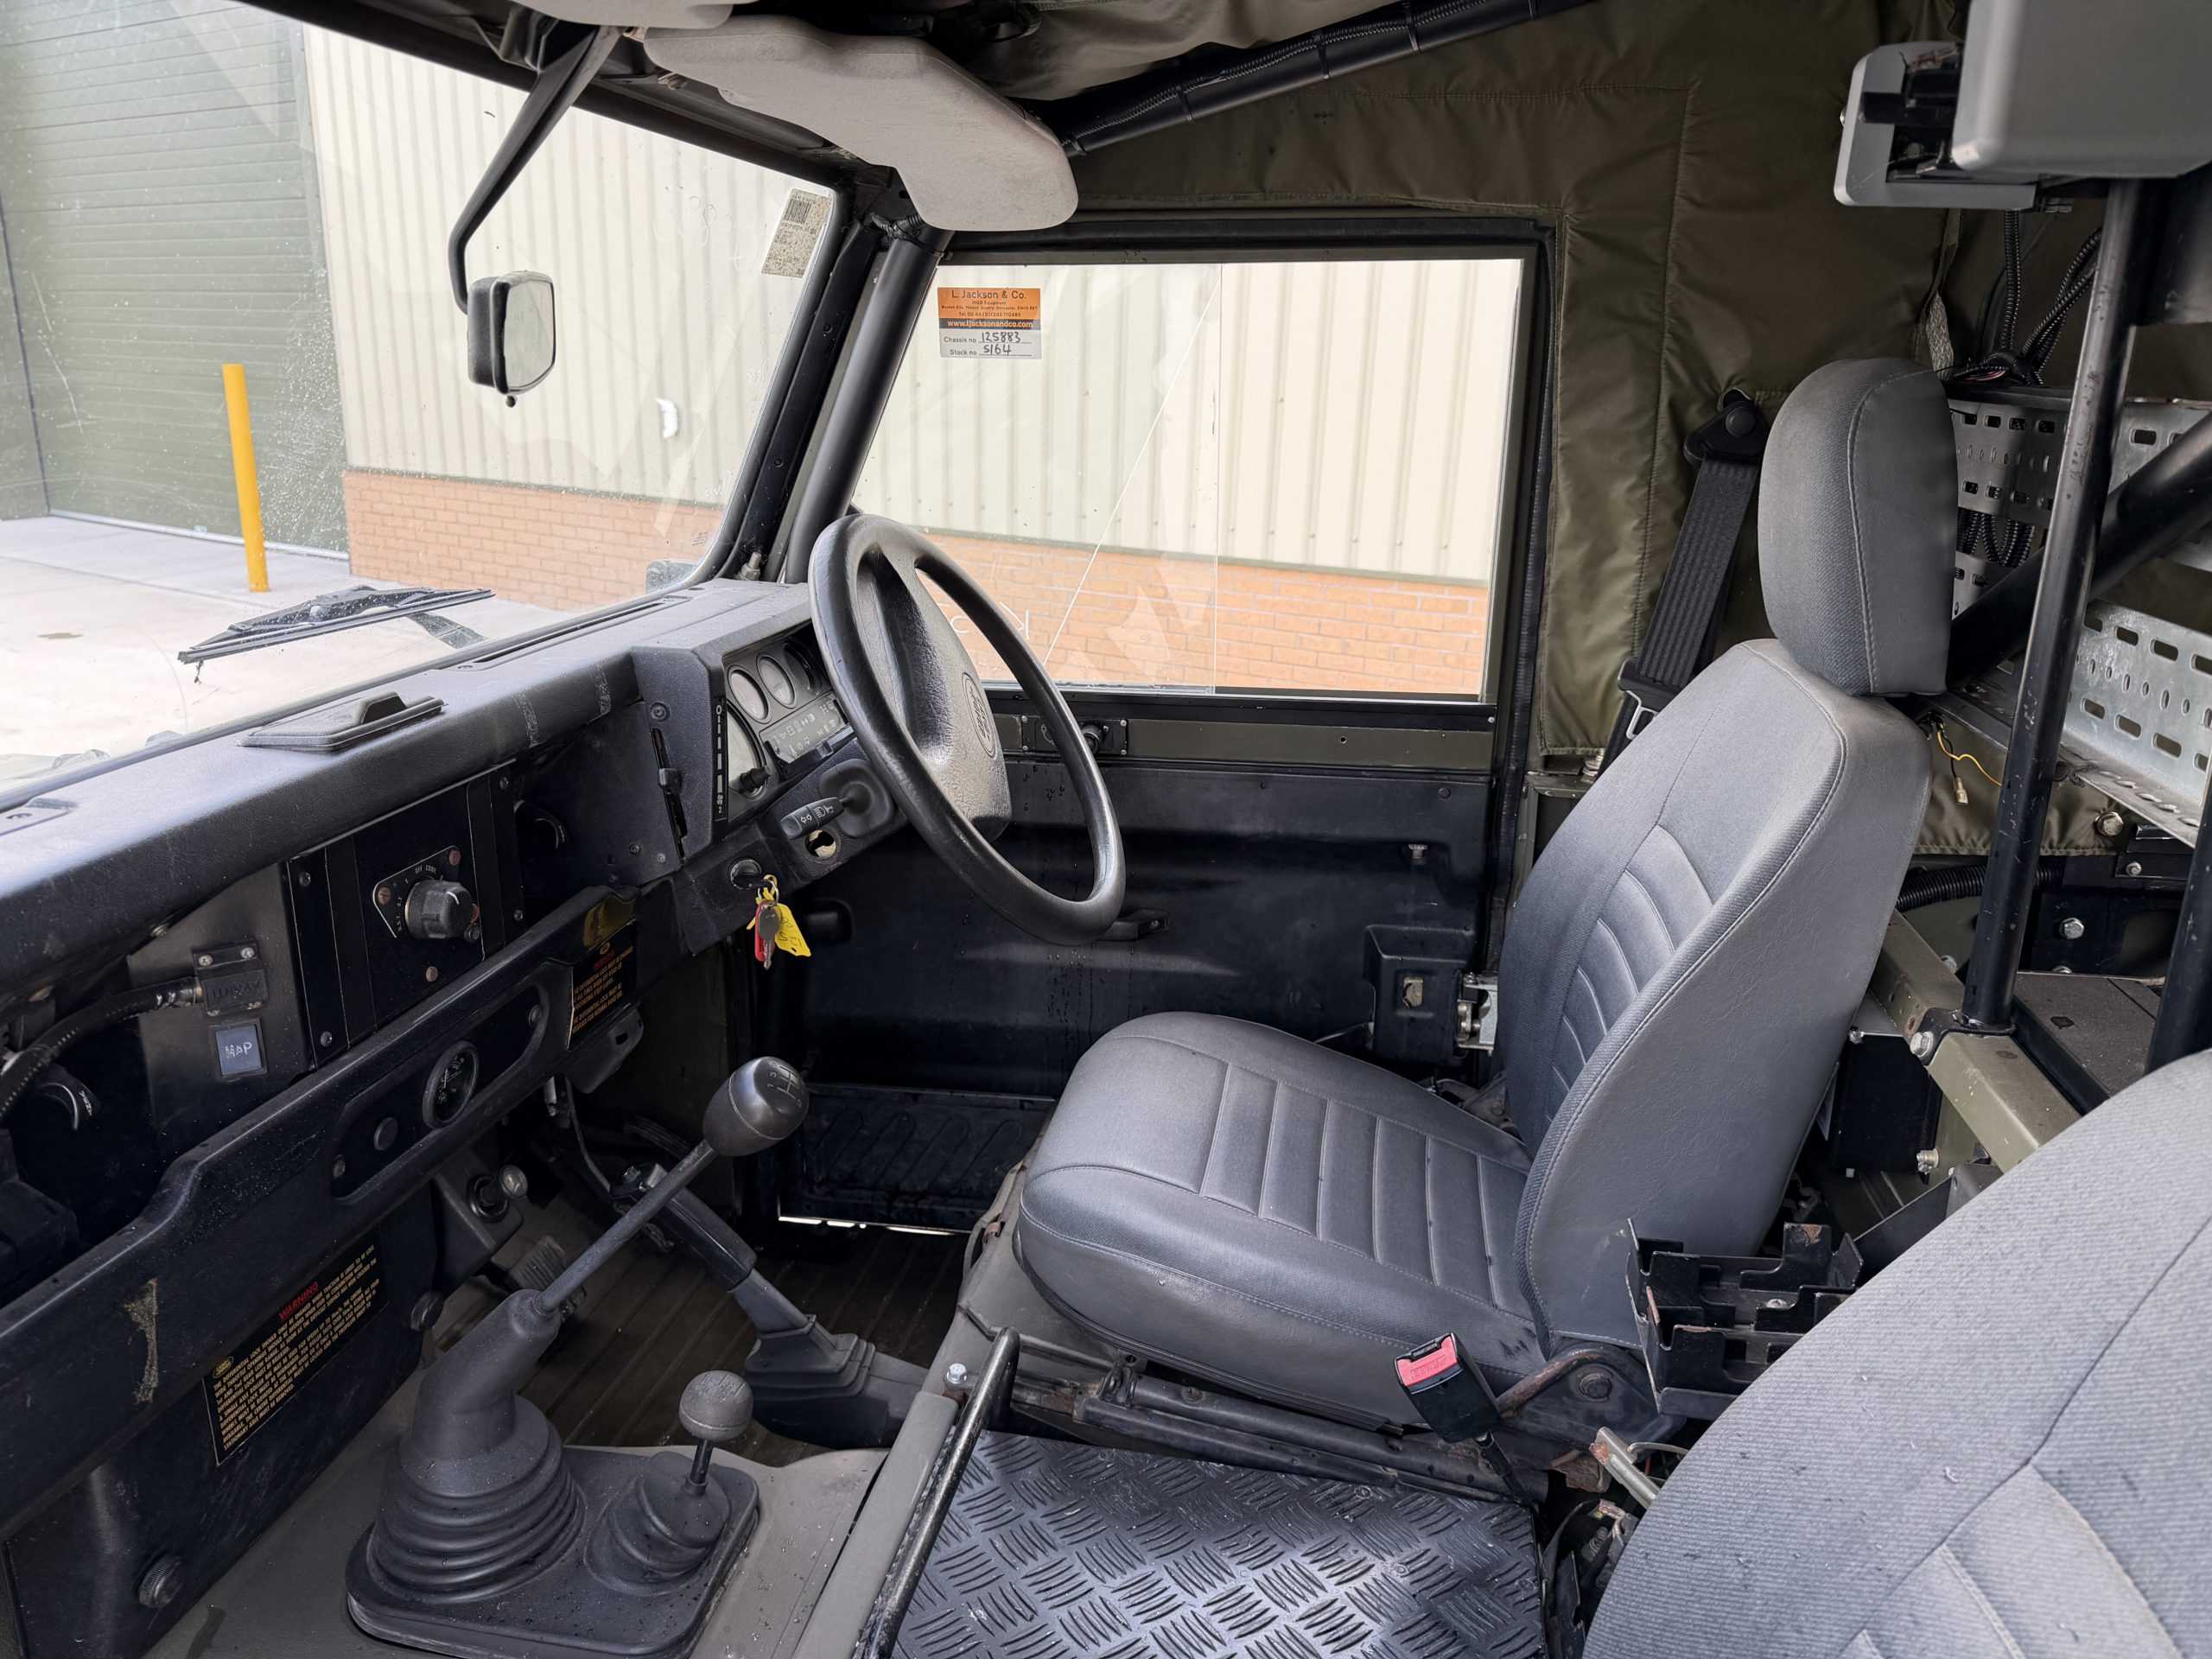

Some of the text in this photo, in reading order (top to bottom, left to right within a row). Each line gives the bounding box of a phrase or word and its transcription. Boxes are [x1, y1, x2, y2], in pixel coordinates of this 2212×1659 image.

[962, 289, 999, 299] Jackson
[1001, 290, 1008, 299] &
[1011, 290, 1027, 299] Co.
[981, 331, 1021, 344] 125883
[79, 1090, 92, 1116] VENT
[280, 1281, 318, 1320] WARNING
